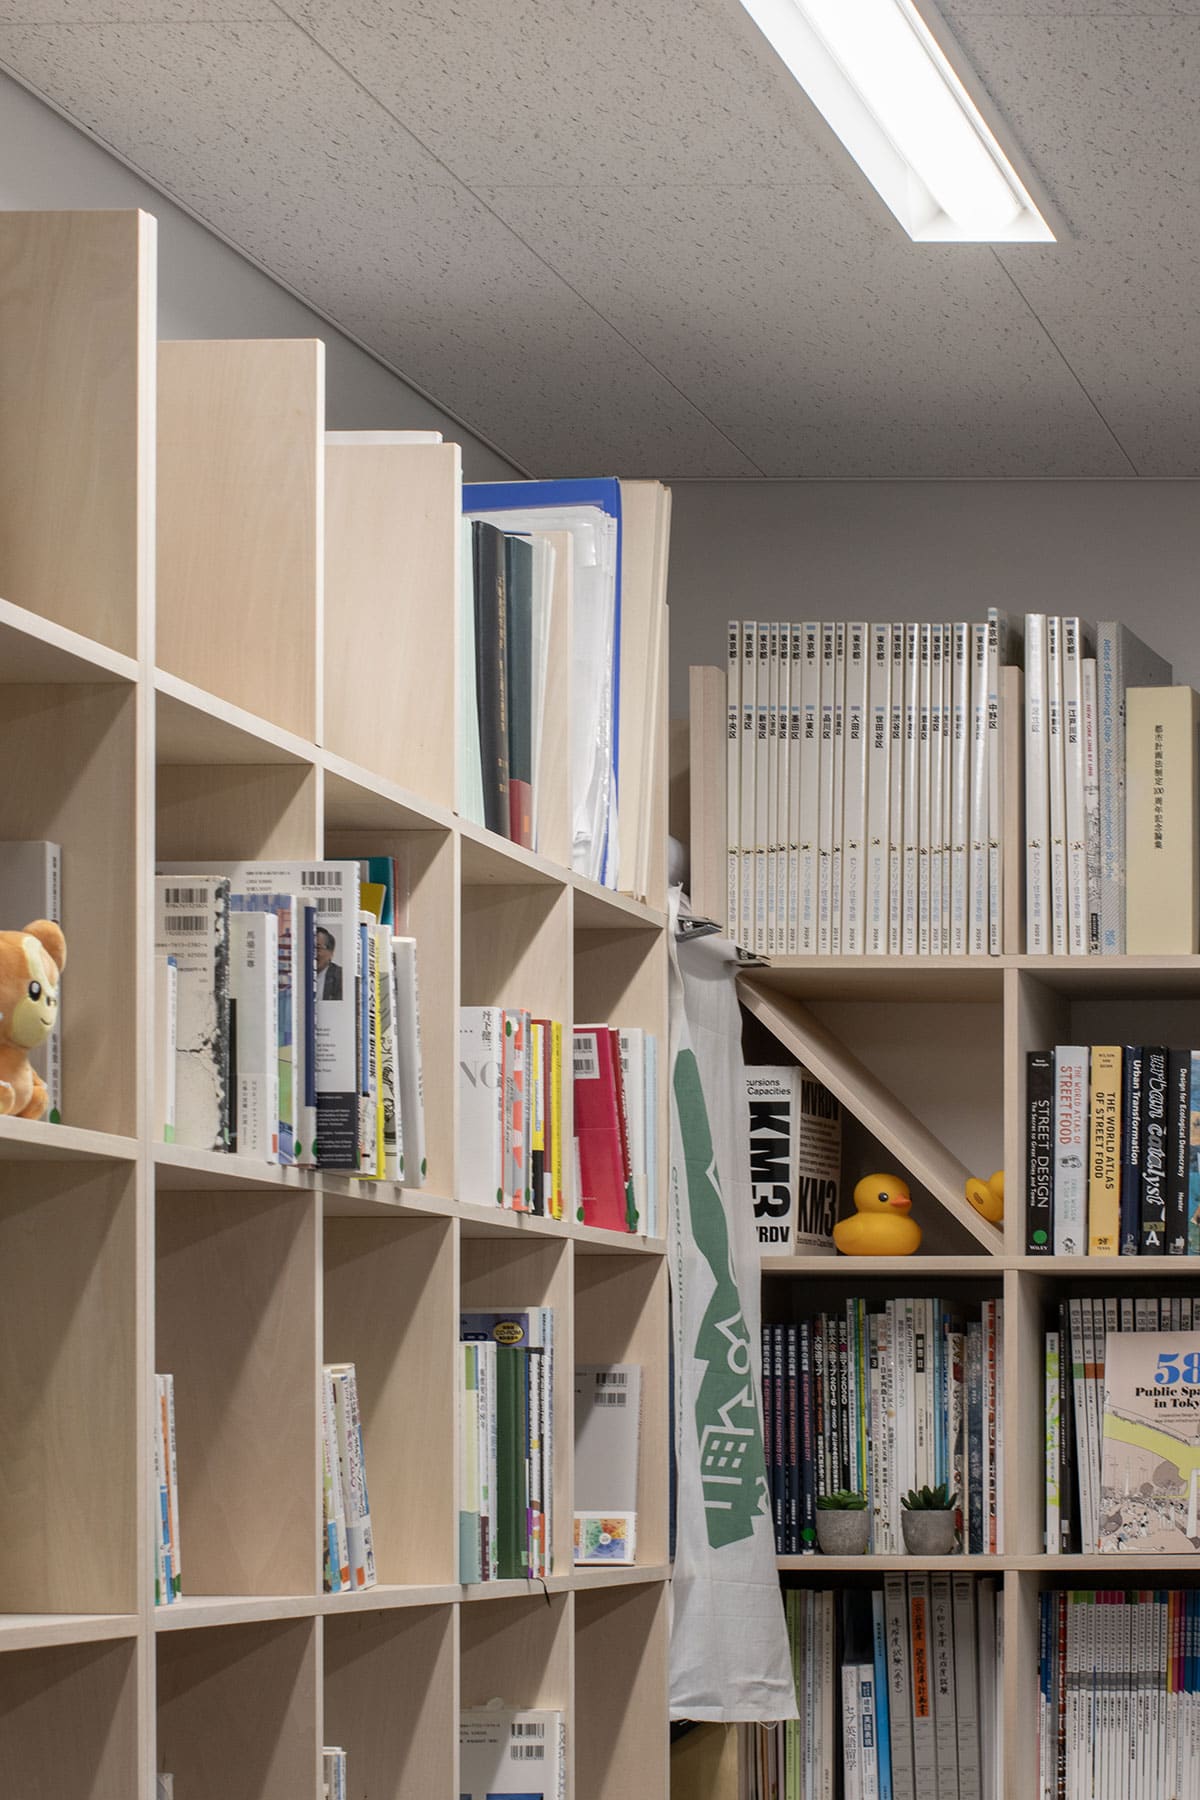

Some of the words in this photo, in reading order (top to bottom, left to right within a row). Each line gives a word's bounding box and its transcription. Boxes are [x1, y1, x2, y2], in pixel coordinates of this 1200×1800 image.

[805, 713, 814, 739] 江東区
[851, 714, 860, 739] 大田区
[988, 704, 997, 729] 中野区
[1074, 1065, 1082, 1079] THE
[1132, 1059, 1142, 1089] Urban
[1178, 1068, 1187, 1092] Design
[747, 1087, 791, 1096] Capacities
[1059, 1065, 1072, 1109] STREET
[1074, 1081, 1082, 1106] WORLD
[1096, 1092, 1104, 1104] OF
[1178, 1092, 1187, 1102] for
[1107, 1092, 1116, 1112] THE
[1037, 1099, 1049, 1150] STREET
[1059, 1112, 1072, 1145] FOOD
[1073, 1109, 1082, 1134] ATLAS
[1095, 1108, 1104, 1148] STREET
[1106, 1113, 1115, 1153] WORLD
[1130, 1091, 1141, 1166] Transformation
[1177, 1104, 1187, 1138] Ecological
[748, 1101, 791, 1218] KM3
[1094, 1150, 1103, 1179] FOOD
[1177, 1139, 1186, 1177] Democracy
[1037, 1156, 1049, 1208] DESIGN
[1105, 1156, 1114, 1190] ATLAS
[797, 1175, 838, 1237] KM3
[1177, 1191, 1185, 1211] Hester
[755, 1226, 790, 1243] RDV
[839, 1320, 847, 1405] 東京大造マップ2020
[1135, 1386, 1177, 1397] Public
[1154, 1398, 1167, 1408] in
